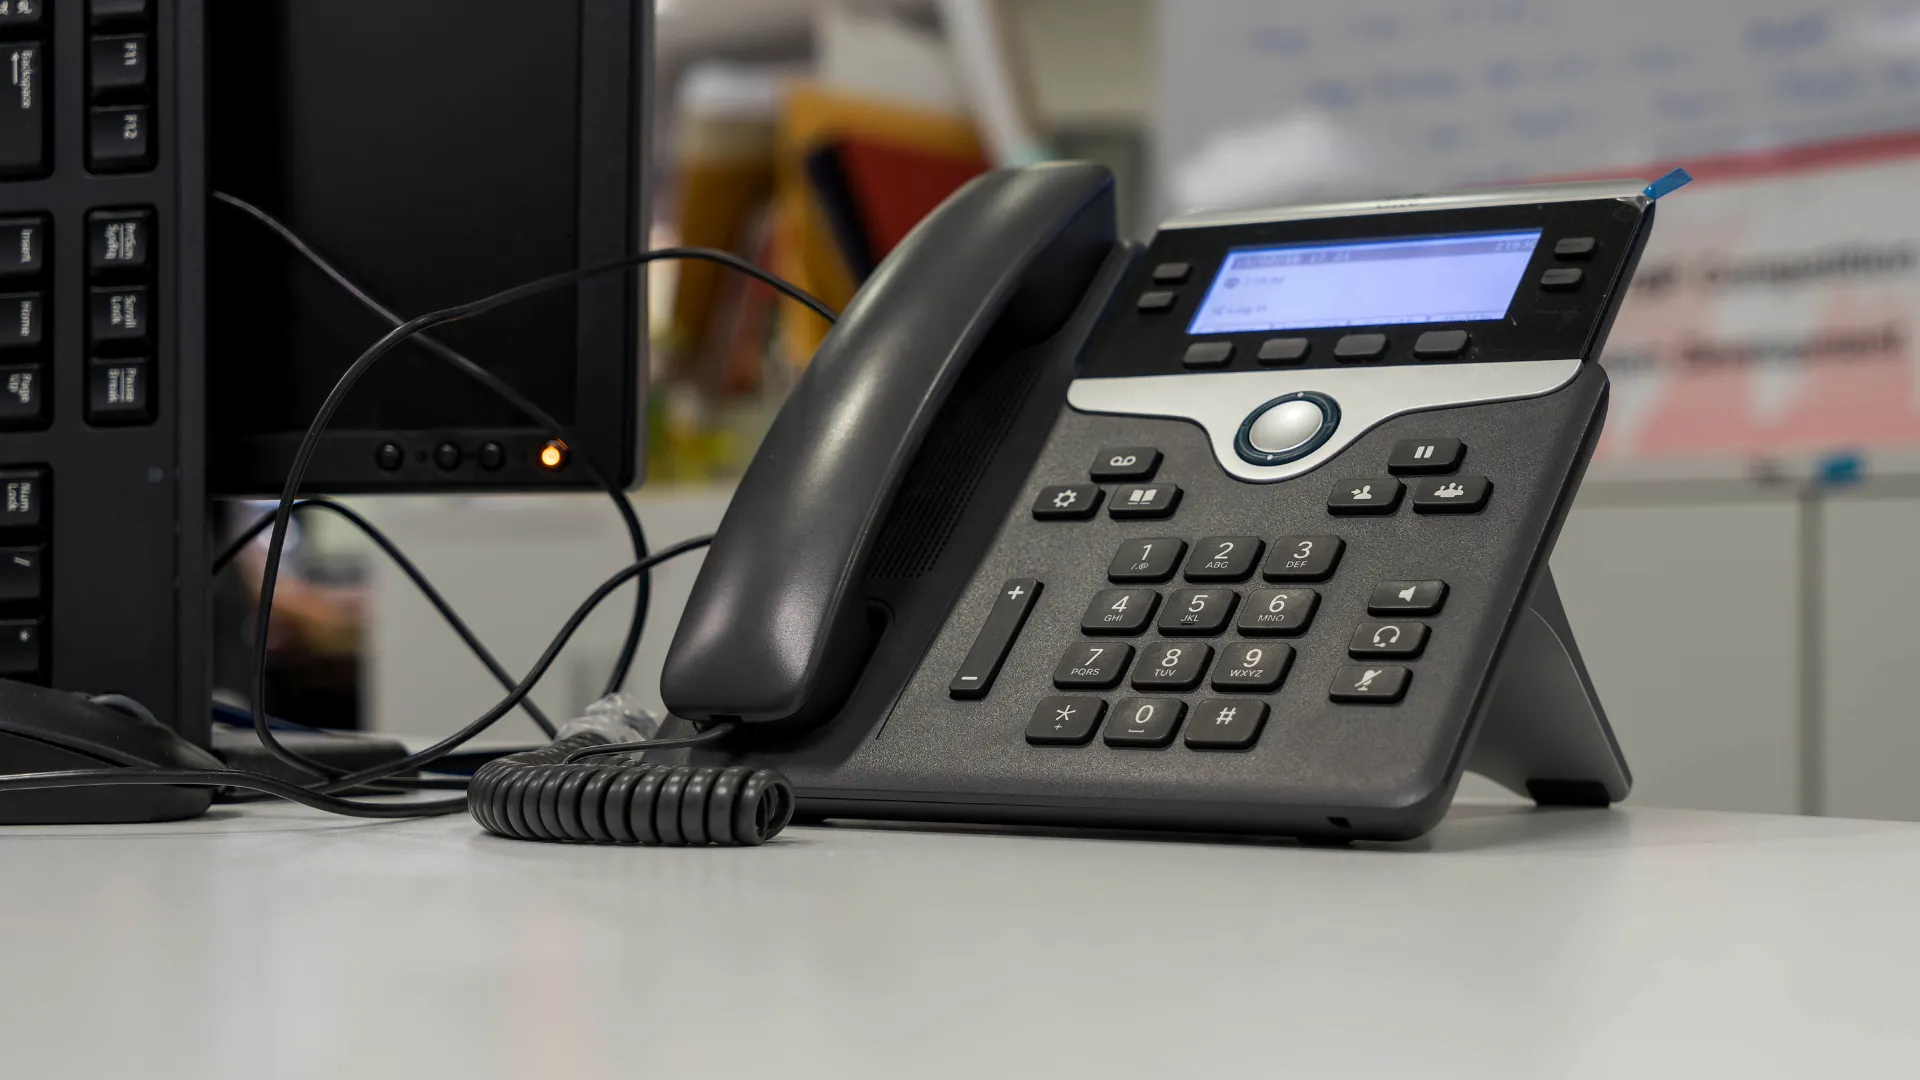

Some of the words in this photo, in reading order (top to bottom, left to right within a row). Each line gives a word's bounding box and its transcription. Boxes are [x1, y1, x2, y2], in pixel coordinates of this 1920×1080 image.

[123, 42, 137, 66] F11
[19, 50, 33, 109] Backspace
[123, 114, 138, 139] F12
[20, 229, 32, 263] Insert
[20, 301, 31, 337] Home
[111, 296, 123, 325] Lock
[124, 295, 137, 329] Scroll
[19, 373, 32, 403] Page
[108, 369, 121, 404] Break
[125, 367, 137, 403] Pause
[6, 482, 19, 513] Lock
[19, 481, 31, 513] Num
[1141, 543, 1153, 561] 1
[1213, 541, 1234, 560] 2
[1293, 540, 1313, 559] 3
[1204, 561, 1229, 569] ABC
[1285, 560, 1308, 568] DEF
[1111, 595, 1130, 613] 4
[1188, 594, 1209, 613] 5
[1268, 594, 1288, 613] 6
[1103, 614, 1124, 622] GHI
[1180, 614, 1199, 622] JKL
[1257, 614, 1285, 622] MNO
[1084, 648, 1104, 666] 7
[1161, 648, 1182, 667] 8
[1243, 648, 1263, 668] 9
[1070, 667, 1101, 677] PQRS
[1154, 668, 1177, 677] TUV
[1229, 669, 1264, 678] WXYZ
[1135, 704, 1155, 724] 0
